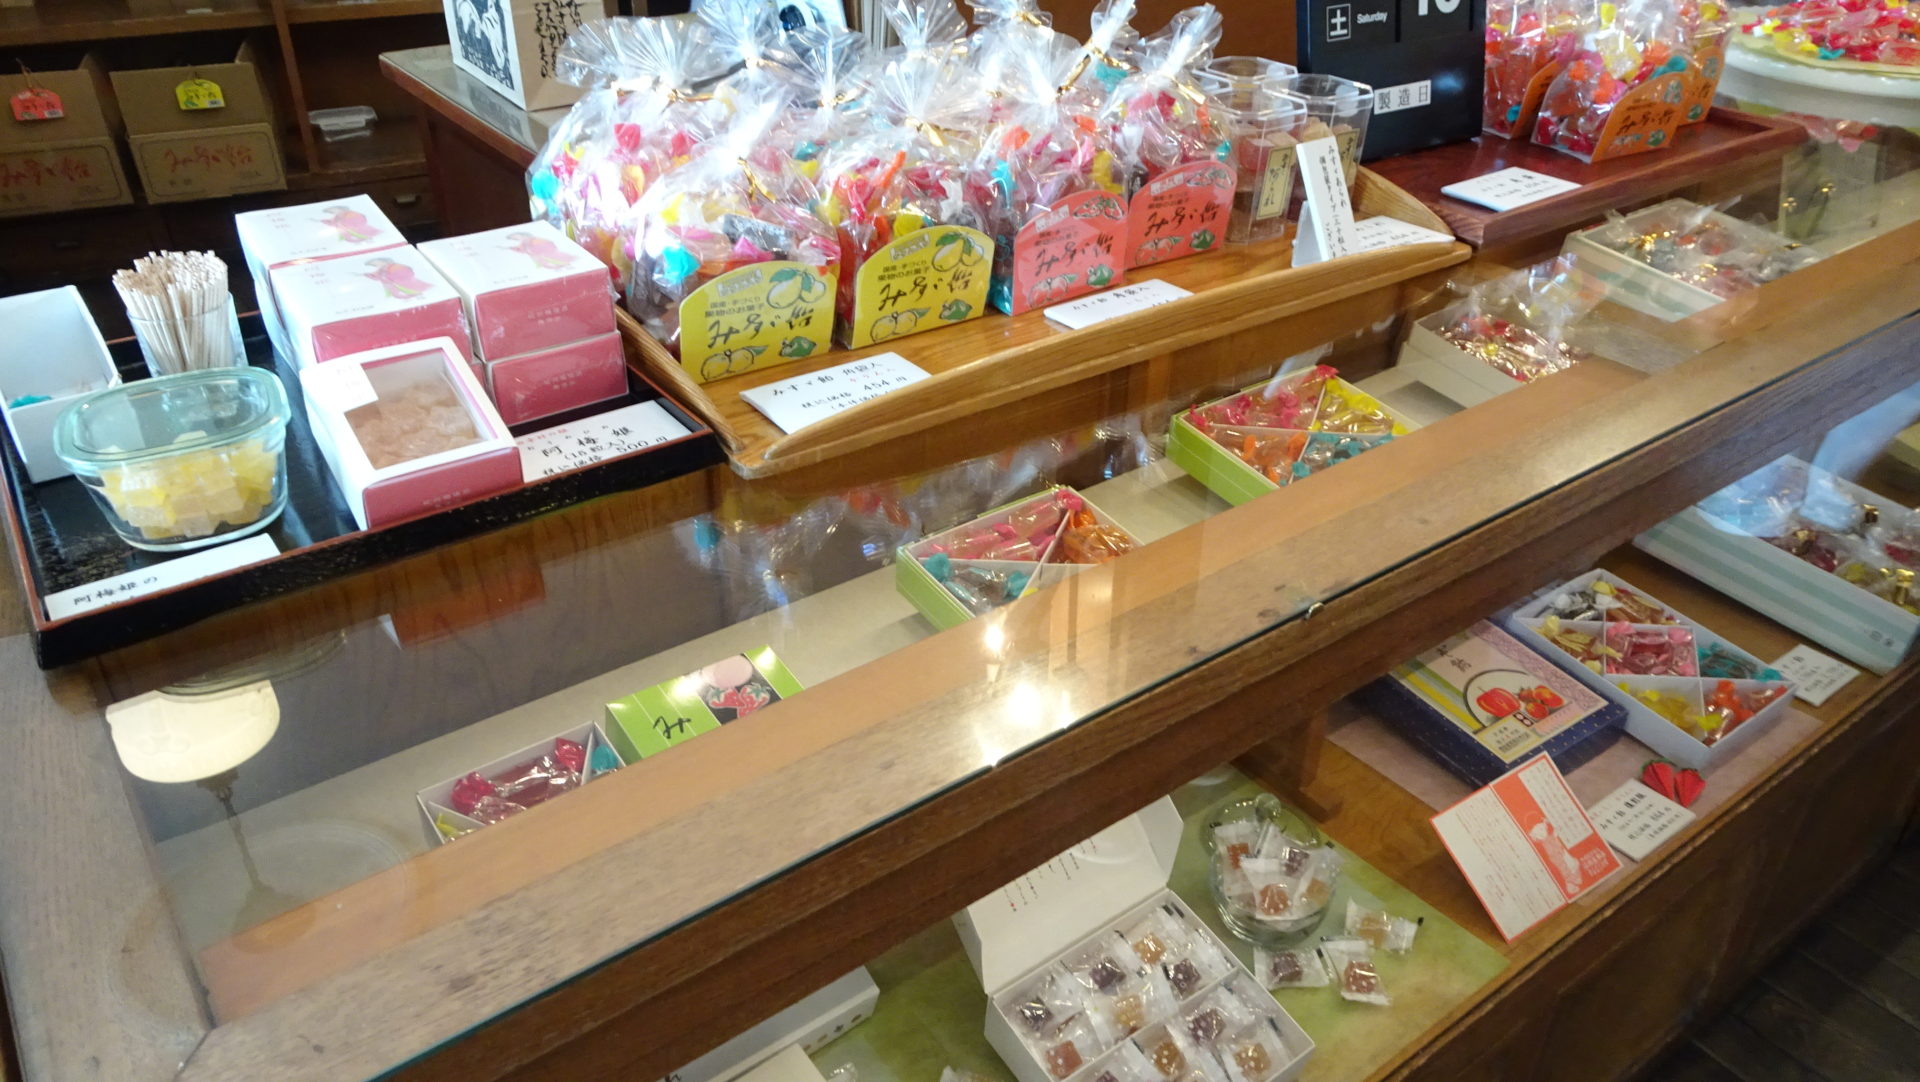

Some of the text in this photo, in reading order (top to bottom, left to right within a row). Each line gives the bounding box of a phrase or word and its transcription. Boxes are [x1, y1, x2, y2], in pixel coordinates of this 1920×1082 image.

[1329, 8, 1348, 37] 土
[1356, 11, 1388, 25] Saturday
[1378, 84, 1430, 110] 製造日
